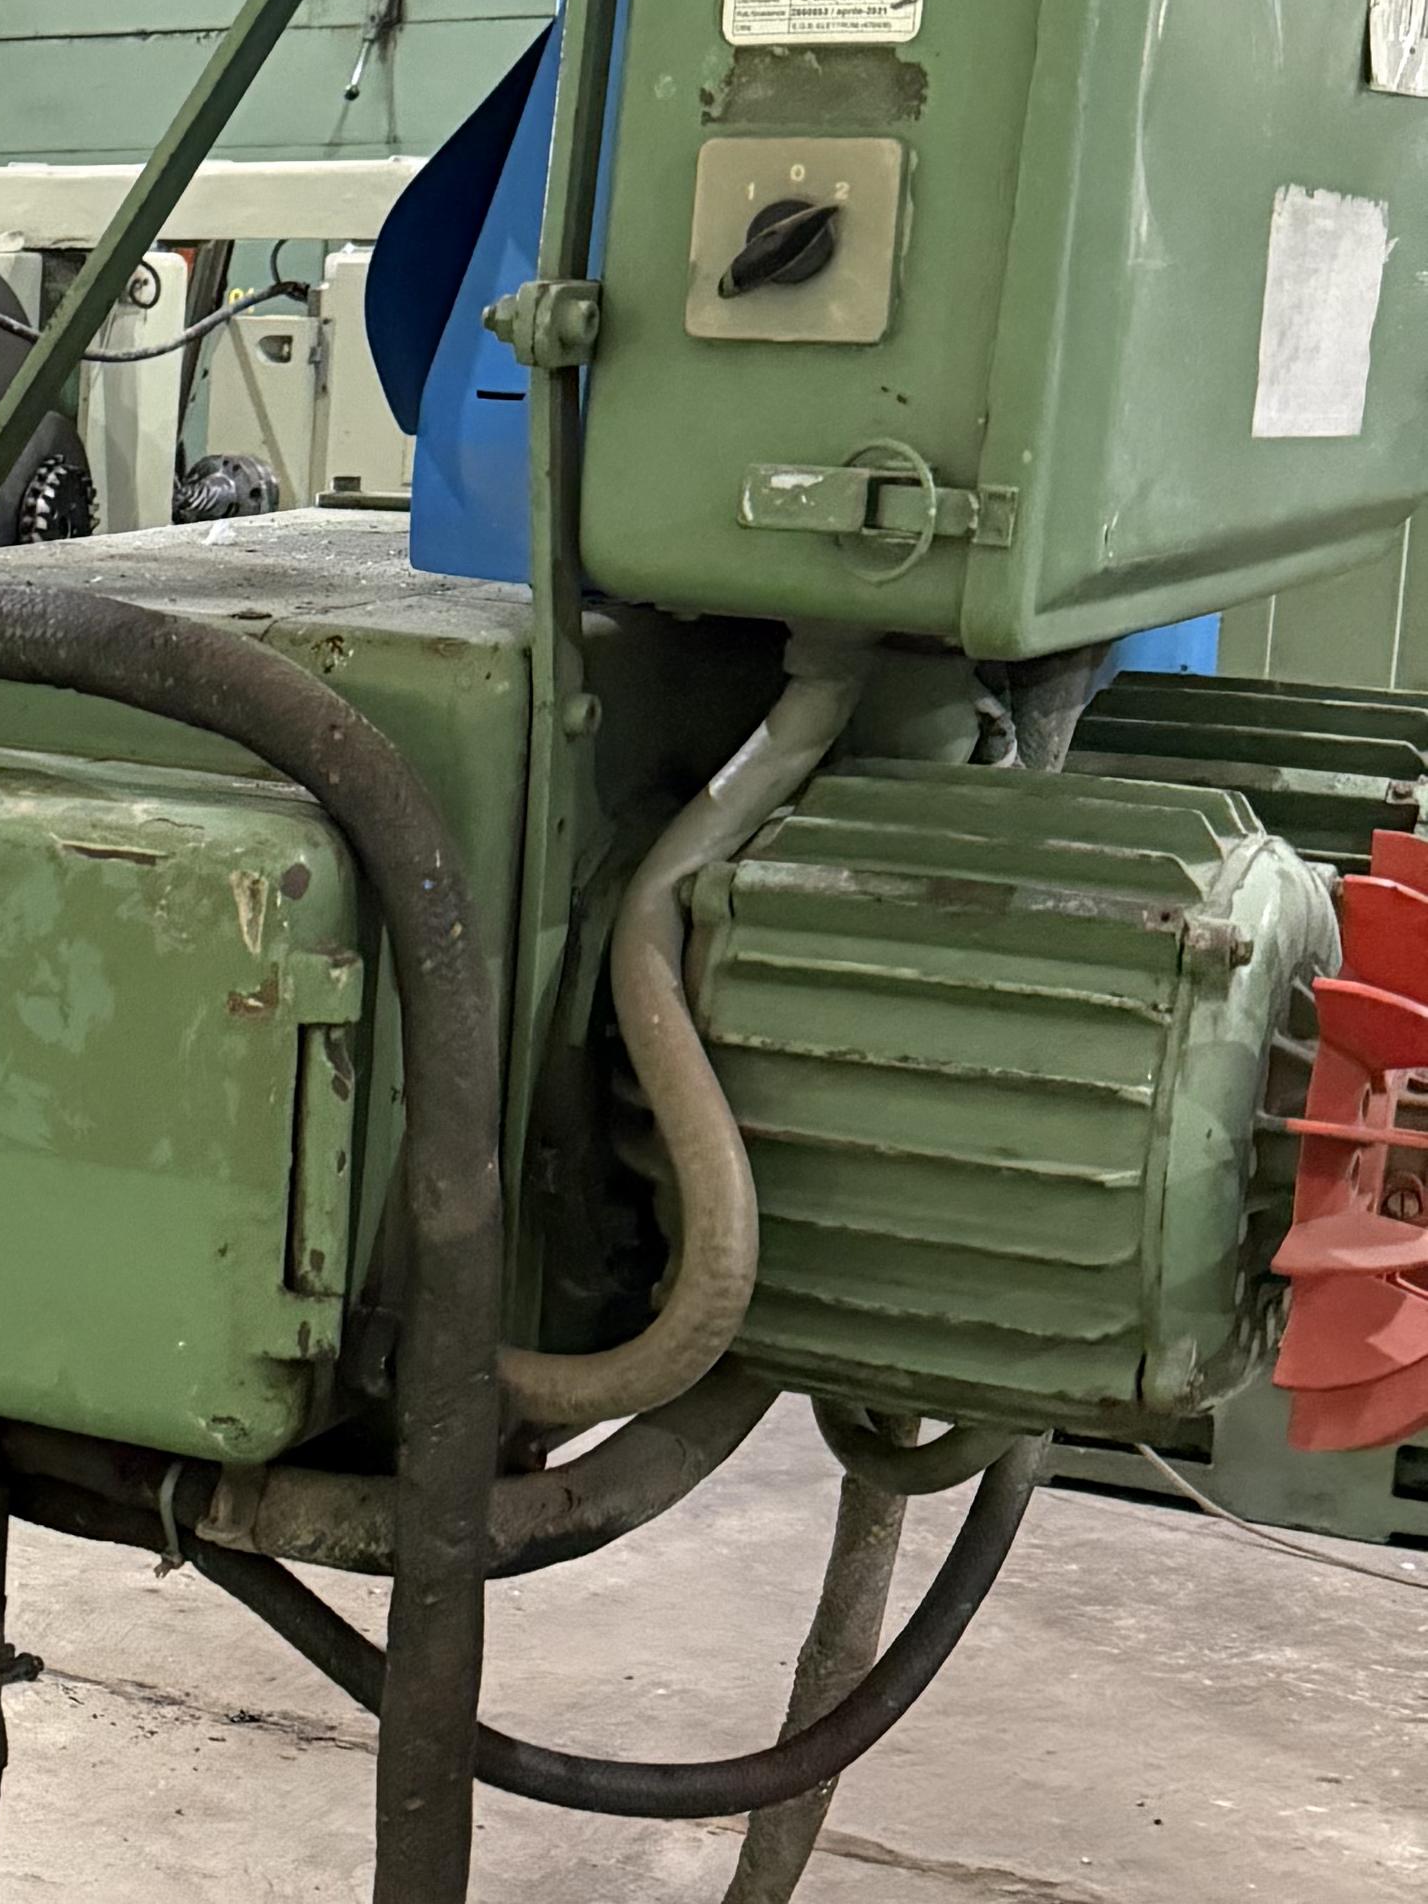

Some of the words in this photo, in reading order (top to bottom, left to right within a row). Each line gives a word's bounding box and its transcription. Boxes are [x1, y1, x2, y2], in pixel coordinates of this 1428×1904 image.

[746, 181, 756, 201] 1
[789, 163, 806, 183] 0
[833, 181, 851, 200] 2
